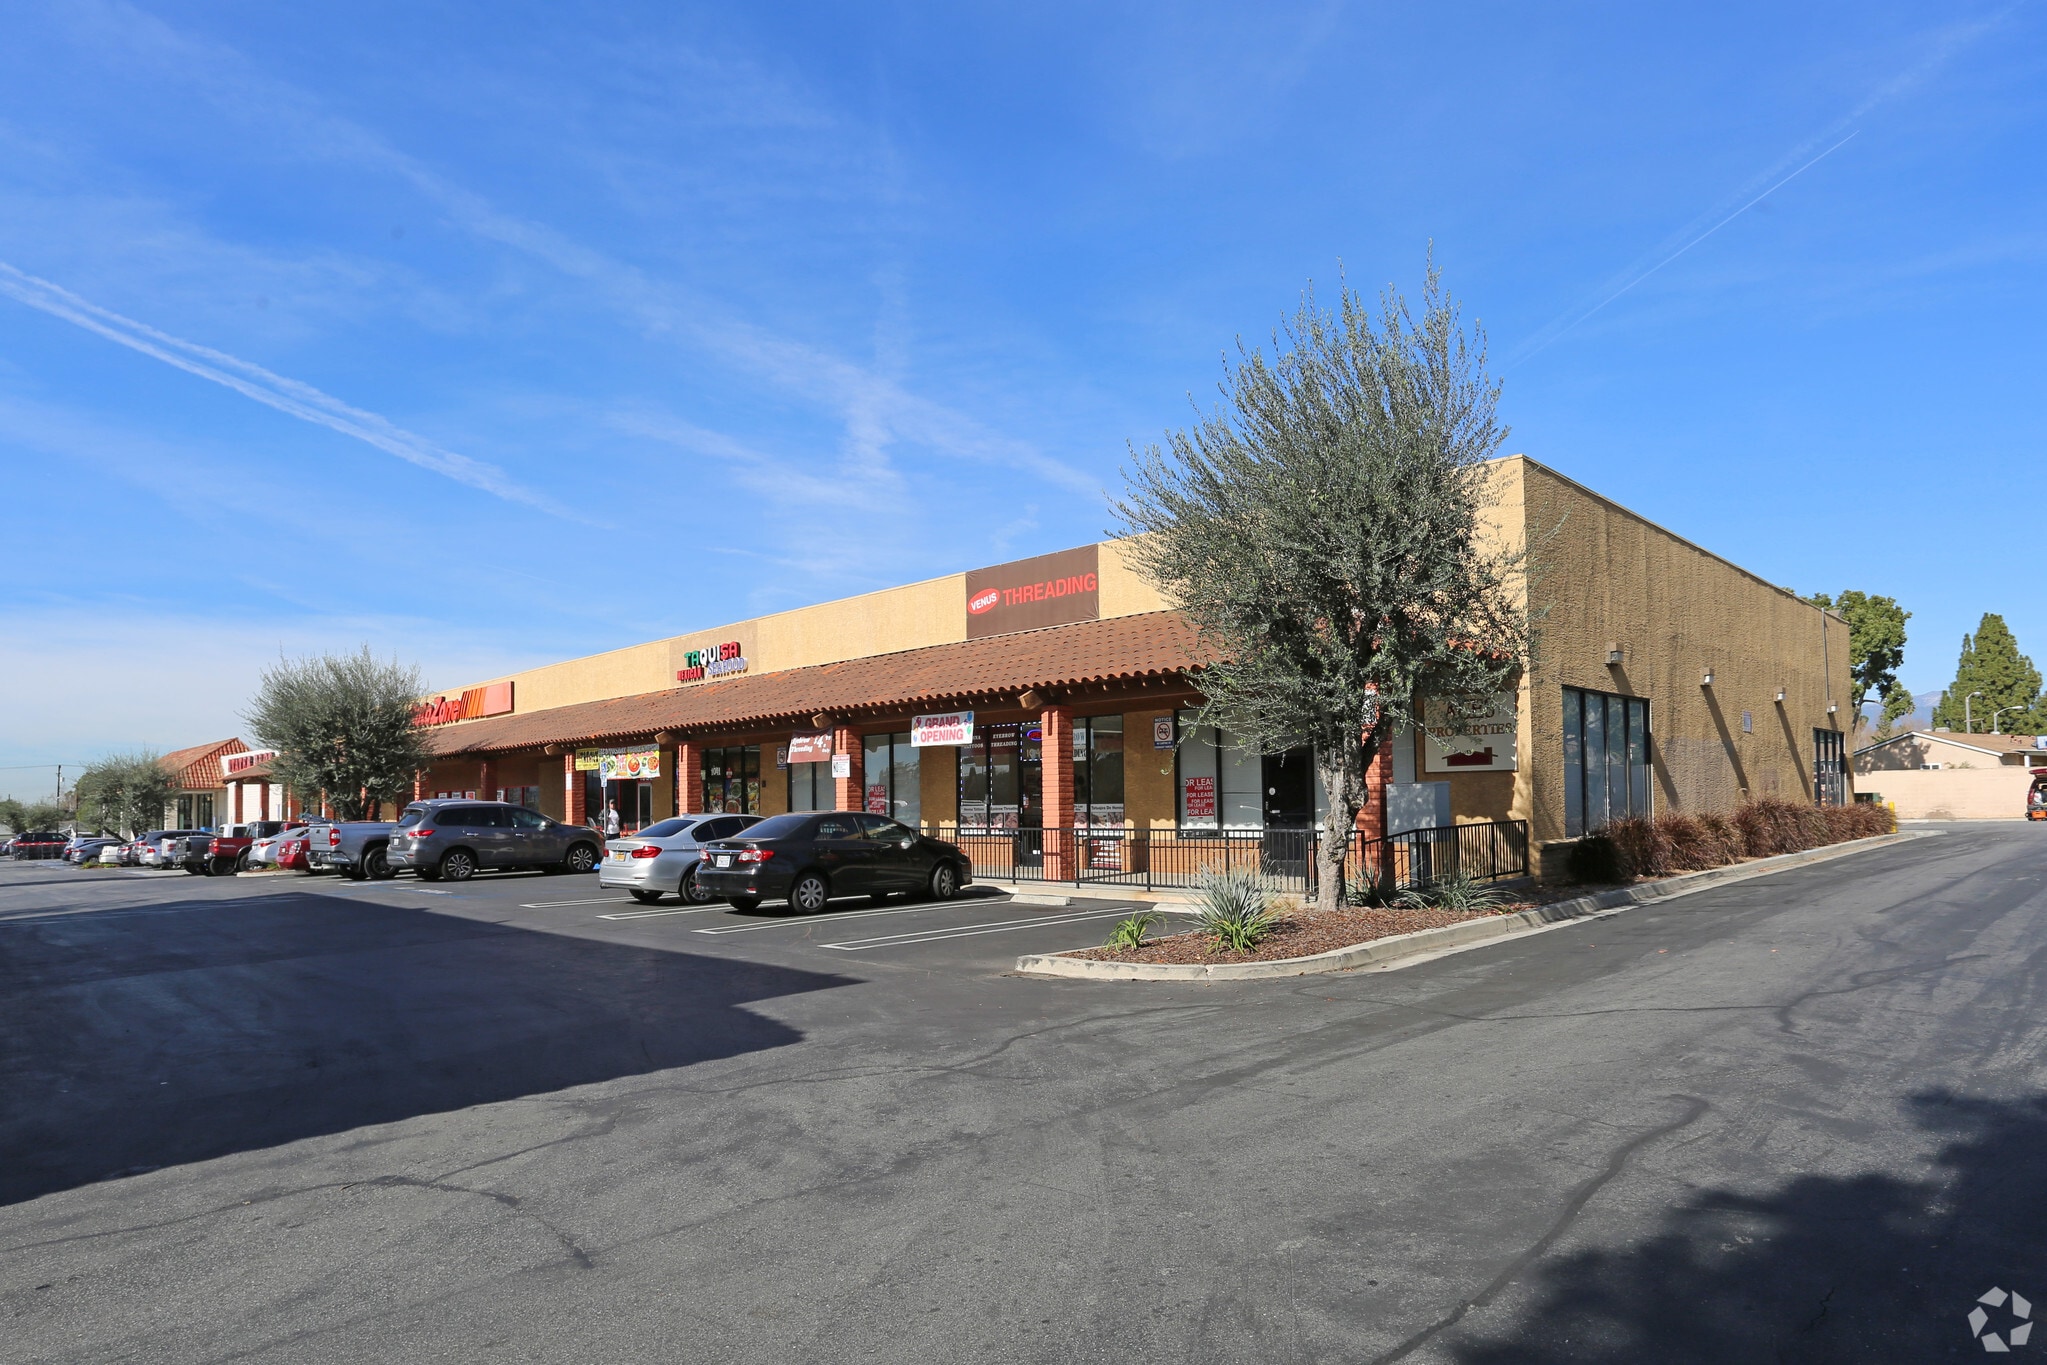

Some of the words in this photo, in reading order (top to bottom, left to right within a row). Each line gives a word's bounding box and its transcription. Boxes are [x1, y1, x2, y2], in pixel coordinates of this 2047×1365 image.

[970, 592, 997, 611] VENUS
[1002, 572, 1097, 607] THREADING
[684, 641, 740, 667] TAQUISA
[677, 667, 704, 681] MEXICAN
[707, 657, 748, 676] SEAFOOD
[924, 715, 960, 729] GRAND
[1427, 722, 1512, 738] PROERTIES
[920, 728, 964, 743] OPENING
[992, 732, 1016, 740] EYEBROW
